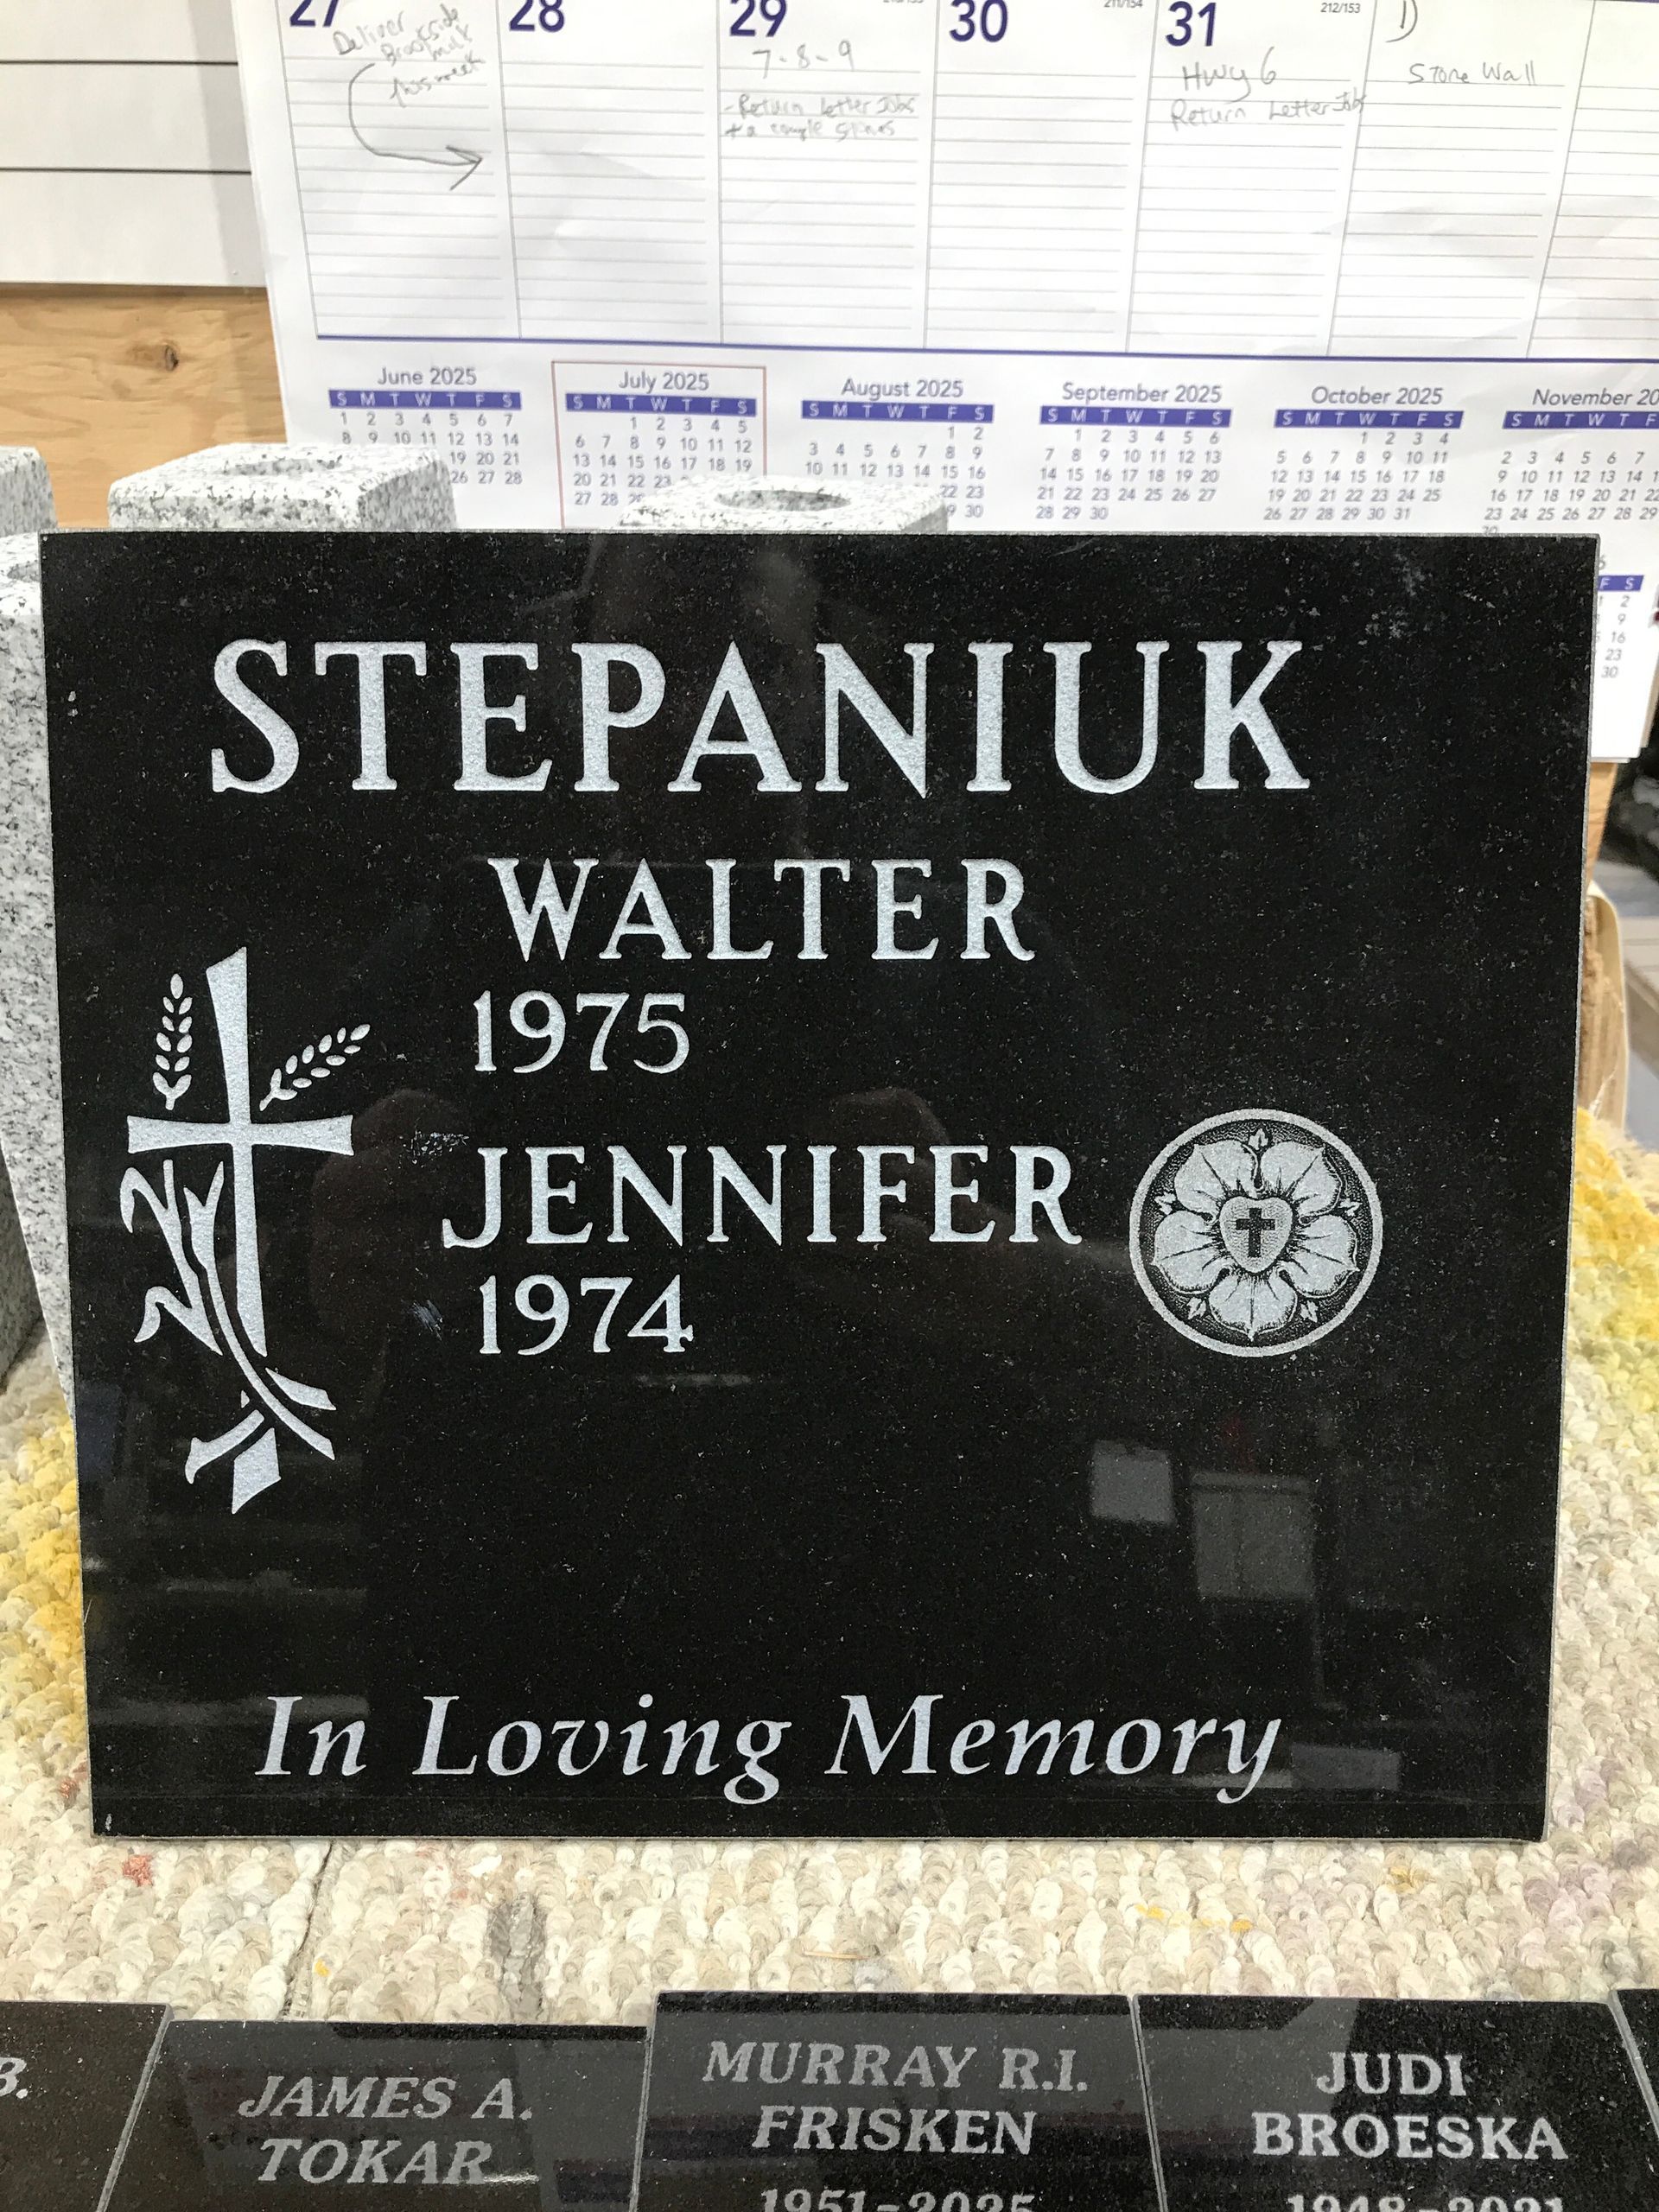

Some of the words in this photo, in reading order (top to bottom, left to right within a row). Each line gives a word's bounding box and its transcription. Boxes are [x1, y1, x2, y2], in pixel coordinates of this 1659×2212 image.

[289, 0, 340, 27] 27
[509, 0, 565, 32] 28
[730, 0, 787, 37] 29
[1320, 3, 1361, 13] 212/153
[950, 0, 1008, 42] 30
[1165, 1, 1217, 46] 31
[378, 367, 423, 385] June
[429, 366, 477, 385] 2025
[618, 370, 658, 393] July
[662, 372, 709, 391] 2025
[841, 378, 910, 400] August
[916, 379, 963, 398] 2025
[1062, 381, 1169, 404] September
[1174, 385, 1222, 404] 2025
[1312, 385, 1391, 404] October
[1395, 387, 1444, 405] 2025
[1532, 387, 1633, 405] November
[1636, 388, 1659, 406] 20
[809, 402, 819, 417] S
[832, 402, 848, 416] M
[862, 404, 873, 417] T
[887, 404, 905, 419] W
[918, 404, 929, 419] T
[947, 405, 957, 419] F
[975, 405, 985, 421] S
[1048, 407, 1058, 423] S
[1071, 408, 1087, 422] M
[1101, 408, 1112, 423] T
[1125, 410, 1143, 423] W
[1157, 410, 1168, 423] T
[1185, 410, 1195, 424] F
[1212, 411, 1222, 426] S
[1281, 411, 1294, 426] S
[1305, 411, 1321, 425] M
[1335, 411, 1345, 425] T
[1359, 412, 1376, 425] W
[1389, 412, 1401, 425] T
[1416, 412, 1428, 426] F
[1443, 412, 1454, 427] S
[341, 431, 353, 445] 8
[368, 431, 378, 444] 9
[394, 431, 411, 445] 10
[421, 431, 436, 444] 11
[448, 431, 465, 446] 12
[475, 432, 493, 447] 13
[503, 433, 519, 446] 14
[575, 435, 585, 448] 6
[602, 435, 611, 448] 7
[630, 435, 639, 450] 8
[656, 436, 666, 449] 9
[680, 437, 698, 451] 10
[708, 438, 723, 451] 11
[734, 439, 752, 454] 12
[449, 451, 467, 466] 19
[476, 452, 494, 466] 20
[503, 452, 519, 466] 21
[574, 454, 590, 467] 13
[600, 454, 617, 467] 14
[628, 454, 645, 469] 15
[654, 455, 671, 470] 16
[681, 456, 697, 471] 17
[709, 457, 726, 472] 18
[735, 459, 752, 472] 19
[450, 470, 468, 485] 26
[478, 470, 495, 484] 27
[505, 471, 523, 485] 28
[805, 461, 823, 475] 10
[832, 462, 848, 476] 11
[860, 463, 877, 478] 12
[887, 464, 904, 478] 13
[914, 465, 931, 478] 14
[941, 465, 958, 480] 15
[969, 466, 986, 480] 16
[1041, 467, 1057, 480] 14
[1068, 467, 1084, 482] 15
[1096, 468, 1113, 482] 16
[1122, 468, 1139, 481] 17
[1149, 469, 1166, 483] 18
[1177, 469, 1193, 482] 19
[1200, 468, 1219, 484] 20
[1272, 469, 1288, 484] 12
[1298, 470, 1313, 484] 13
[1325, 470, 1340, 482] 14
[1351, 469, 1366, 484] 15
[1376, 470, 1391, 484] 16
[1403, 469, 1420, 482] 17
[1429, 470, 1445, 484] 18
[937, 484, 958, 499] 22
[965, 485, 984, 499] 23
[1037, 486, 1054, 500] 21
[1063, 486, 1083, 501] 22
[1090, 486, 1110, 501] 23
[1117, 487, 1135, 501] 24
[1144, 487, 1163, 502] 25
[1171, 487, 1191, 502] 26
[1198, 487, 1217, 502] 27
[1268, 488, 1285, 502] 19
[1292, 488, 1311, 503] 20
[1319, 488, 1337, 503] 21
[1344, 488, 1363, 503] 22
[1370, 488, 1389, 503] 23
[1397, 488, 1415, 502] 24
[1422, 488, 1440, 502] 25
[1484, 507, 1503, 521] 23
[1510, 507, 1529, 521] 24
[1536, 507, 1555, 521] 25
[1561, 507, 1580, 521] 26
[1587, 506, 1606, 520] 27
[1613, 506, 1632, 520] 28
[1639, 506, 1658, 520] 29
[212, 639, 1309, 798] STEPANIUK
[487, 859, 1034, 961] WALTER
[474, 991, 689, 1073] 1975
[442, 1145, 1082, 1248] JENNIFER
[480, 1275, 693, 1355] 1974
[255, 1697, 365, 1776] In
[413, 1694, 791, 1804] Loving
[824, 1695, 1281, 1803] Memory
[702, 2040, 977, 2088] MURRAY
[997, 2048, 1089, 2092] R.I.
[1316, 2051, 1468, 2096] JUDI
[238, 2075, 456, 2120] JAMES
[472, 2076, 534, 2120] A.
[752, 2105, 1037, 2155] FRISKEN
[1251, 2111, 1568, 2159] BROESKA
[258, 2139, 492, 2184] TOKAR
